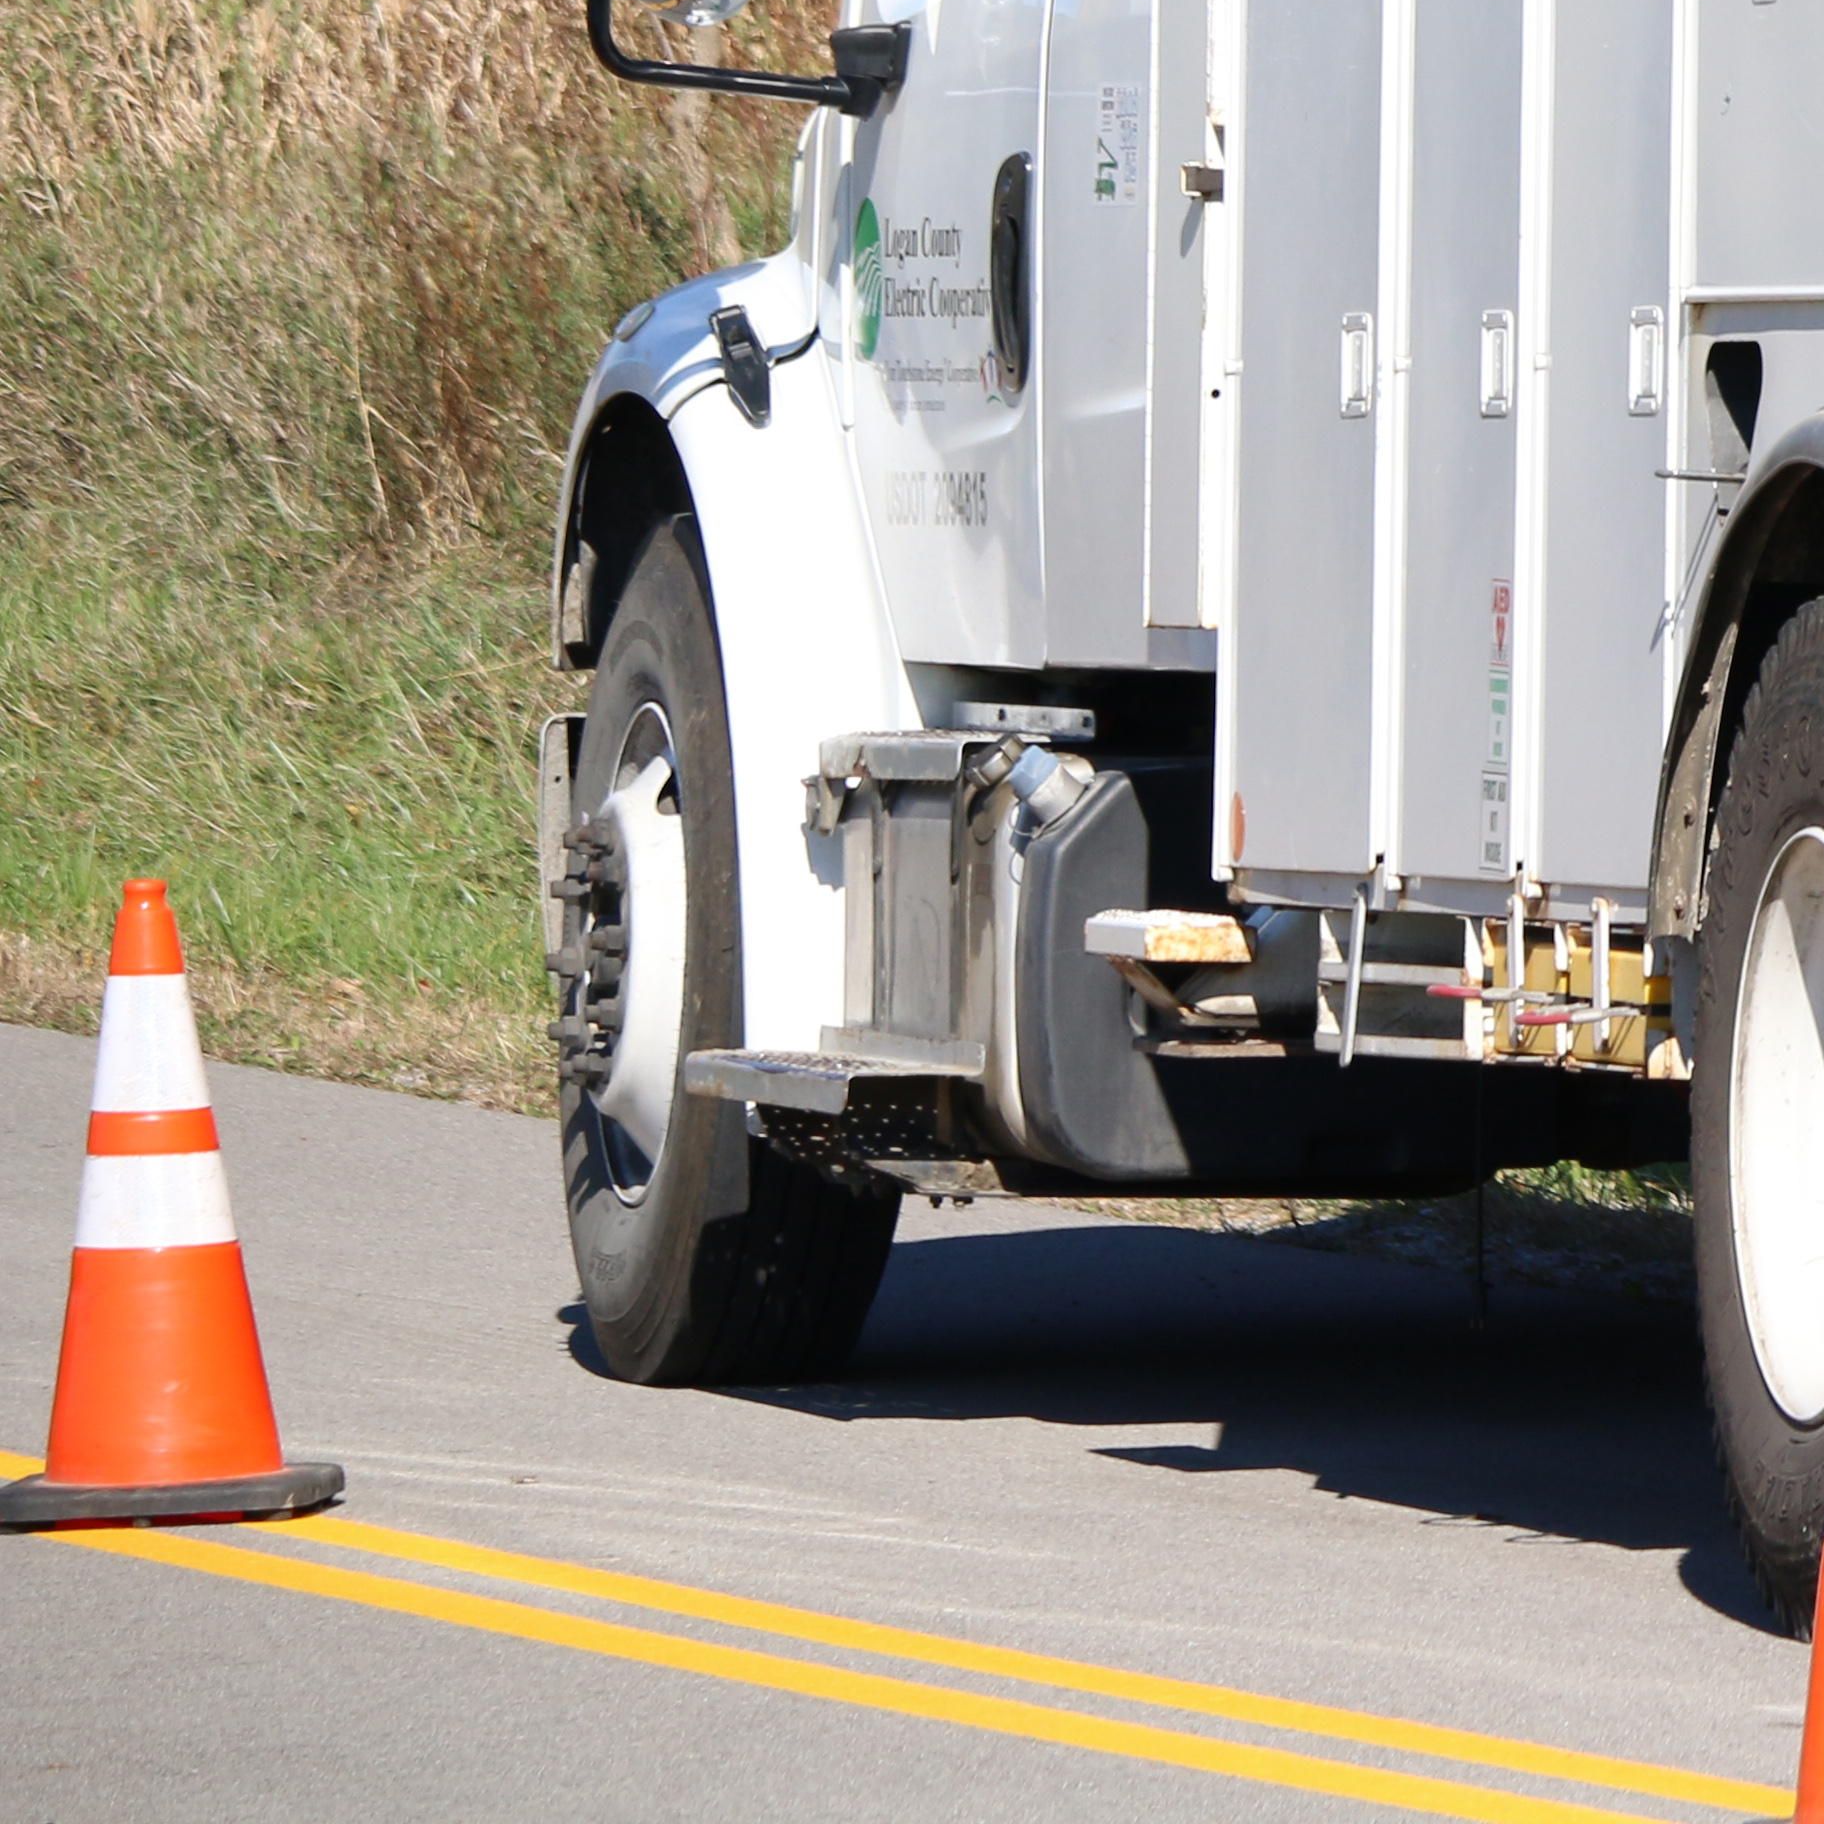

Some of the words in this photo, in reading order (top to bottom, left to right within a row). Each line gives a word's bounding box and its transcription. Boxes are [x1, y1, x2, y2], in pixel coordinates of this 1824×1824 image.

[884, 217, 919, 269] Logan
[921, 216, 963, 269] County
[884, 277, 926, 318] Electric
[928, 277, 992, 328] Cooperativ
